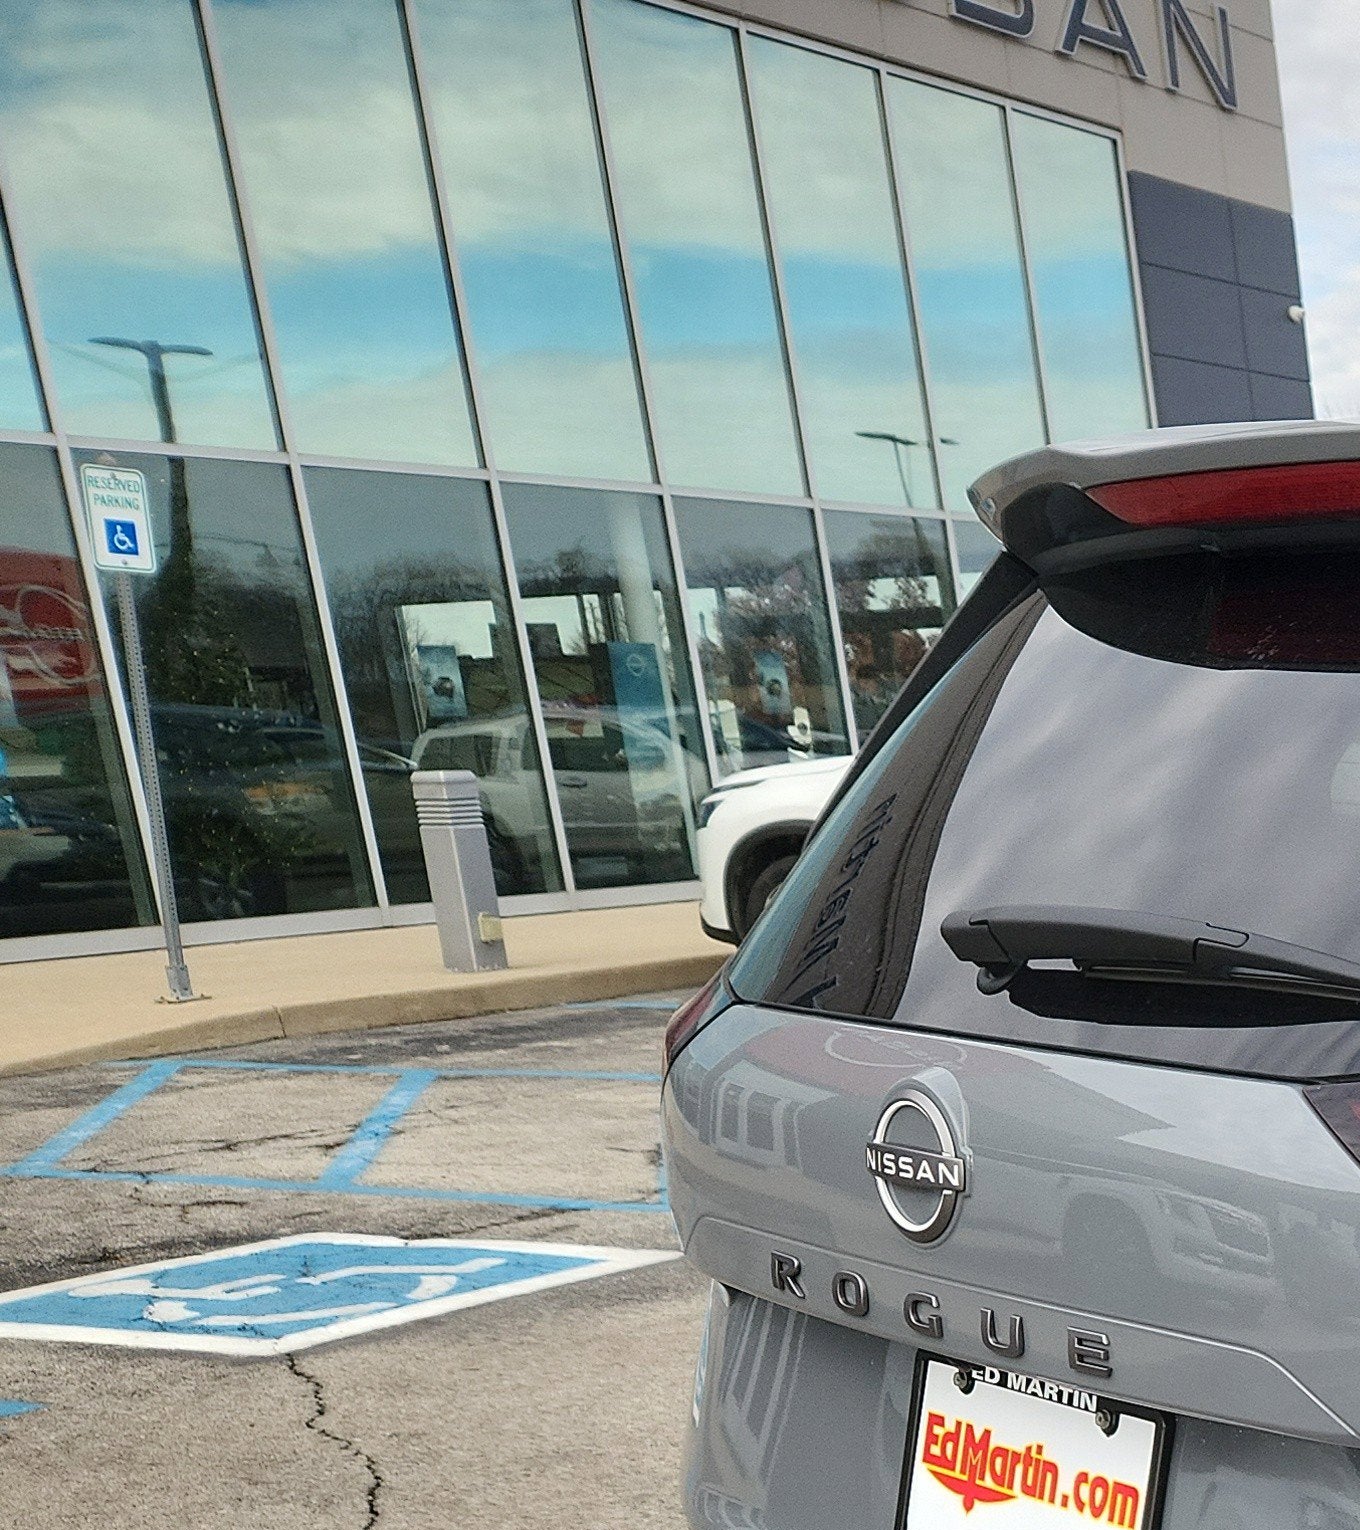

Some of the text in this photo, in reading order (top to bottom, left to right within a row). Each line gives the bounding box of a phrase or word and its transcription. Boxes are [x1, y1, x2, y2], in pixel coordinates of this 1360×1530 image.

[86, 475, 140, 493] RESERVED
[94, 493, 140, 511] PARKING
[866, 1146, 961, 1187] NISSAN
[770, 1249, 1113, 1378] ROGUE
[971, 1366, 1099, 1413] ED MARTIN
